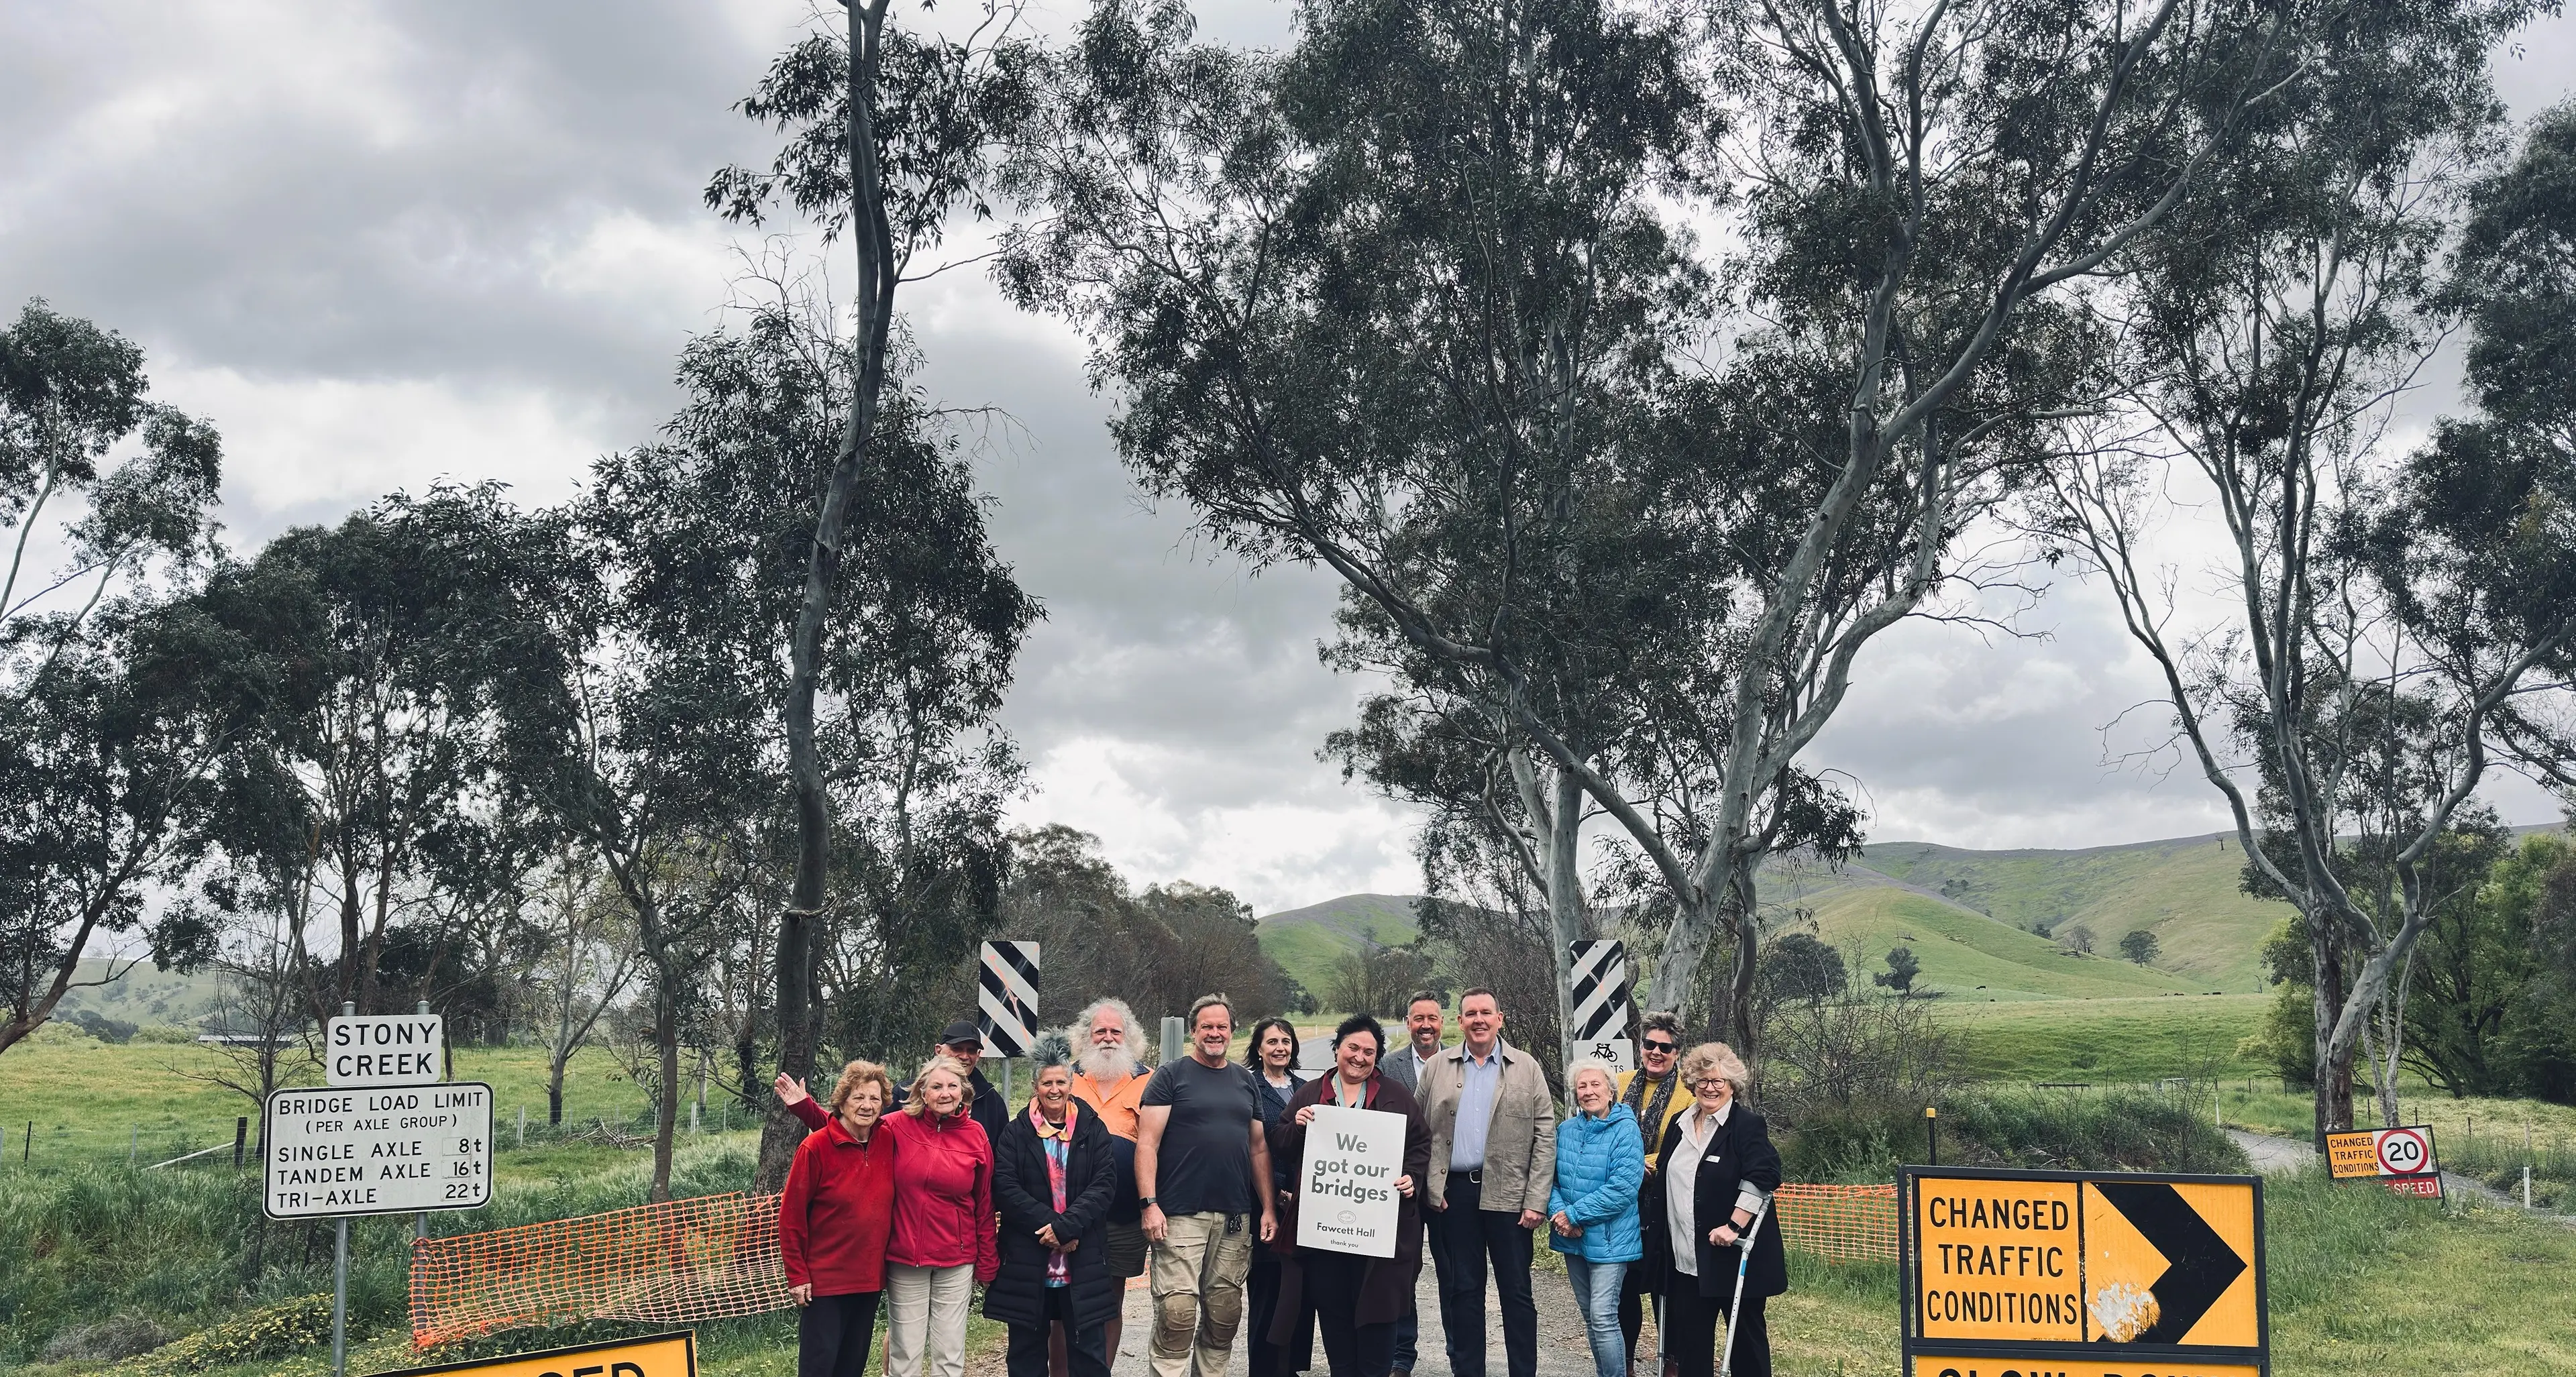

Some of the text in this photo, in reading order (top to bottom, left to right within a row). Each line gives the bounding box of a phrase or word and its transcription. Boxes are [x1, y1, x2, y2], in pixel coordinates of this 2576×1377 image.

[334, 1022, 437, 1047] STONY
[335, 1052, 433, 1077] CREEK
[278, 1091, 483, 1116] BRIDGE LOAD LIMIT
[354, 1118, 390, 1131] AXLE
[278, 1143, 354, 1164] SINGLE
[370, 1140, 422, 1158] AXLE
[1336, 1132, 1368, 1154] We
[2330, 1137, 2419, 1162] CHANGED 20
[2334, 1150, 2374, 1161] TRAFFIC
[277, 1166, 363, 1187] TANDEM
[379, 1162, 431, 1180] AXLE
[1314, 1158, 1390, 1178] got our
[2332, 1162, 2379, 1174] CONDITIONS
[276, 1188, 377, 1209] TRI-AXLE
[1311, 1175, 1389, 1204] bridges
[2394, 1181, 2435, 1195] SPEED
[1929, 1196, 2070, 1231] CHANGED
[1316, 1221, 1375, 1238] Fawcett Hall
[1330, 1239, 1347, 1247] thank
[1937, 1244, 2064, 1278] TRAFFIC
[1927, 1289, 2078, 1325] CONDITIONS
